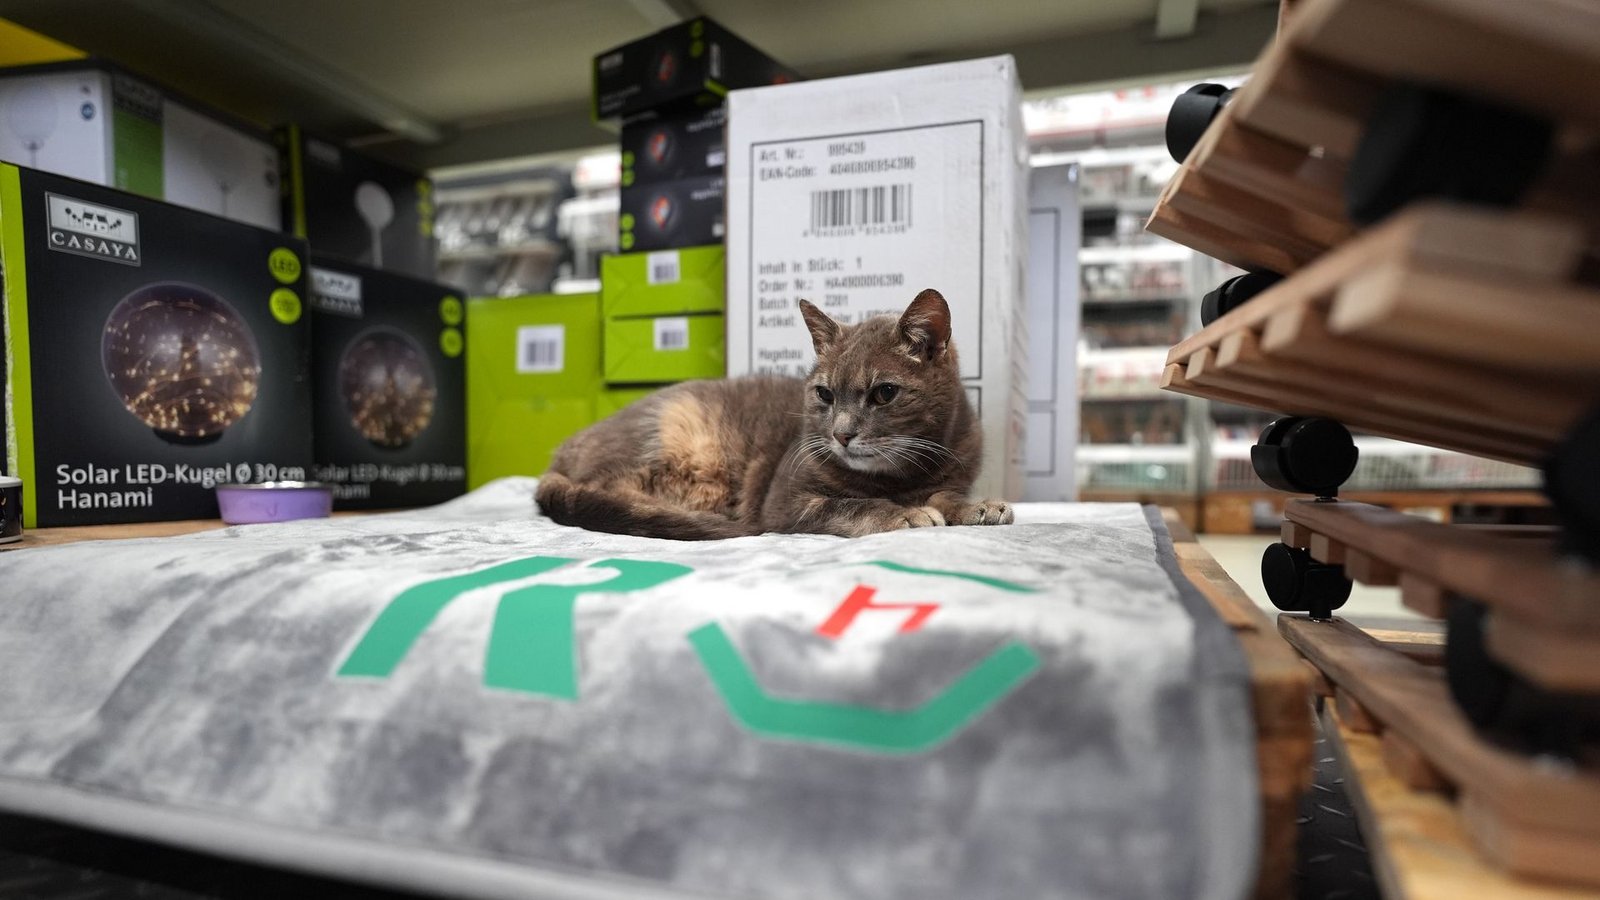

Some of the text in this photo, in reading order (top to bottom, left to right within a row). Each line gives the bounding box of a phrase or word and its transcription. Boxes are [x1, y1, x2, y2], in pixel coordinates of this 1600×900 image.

[51, 231, 137, 260] CASAYA
[56, 463, 120, 485] Solar
[125, 463, 232, 489] LED-Kugel
[57, 487, 154, 510] Hanami
